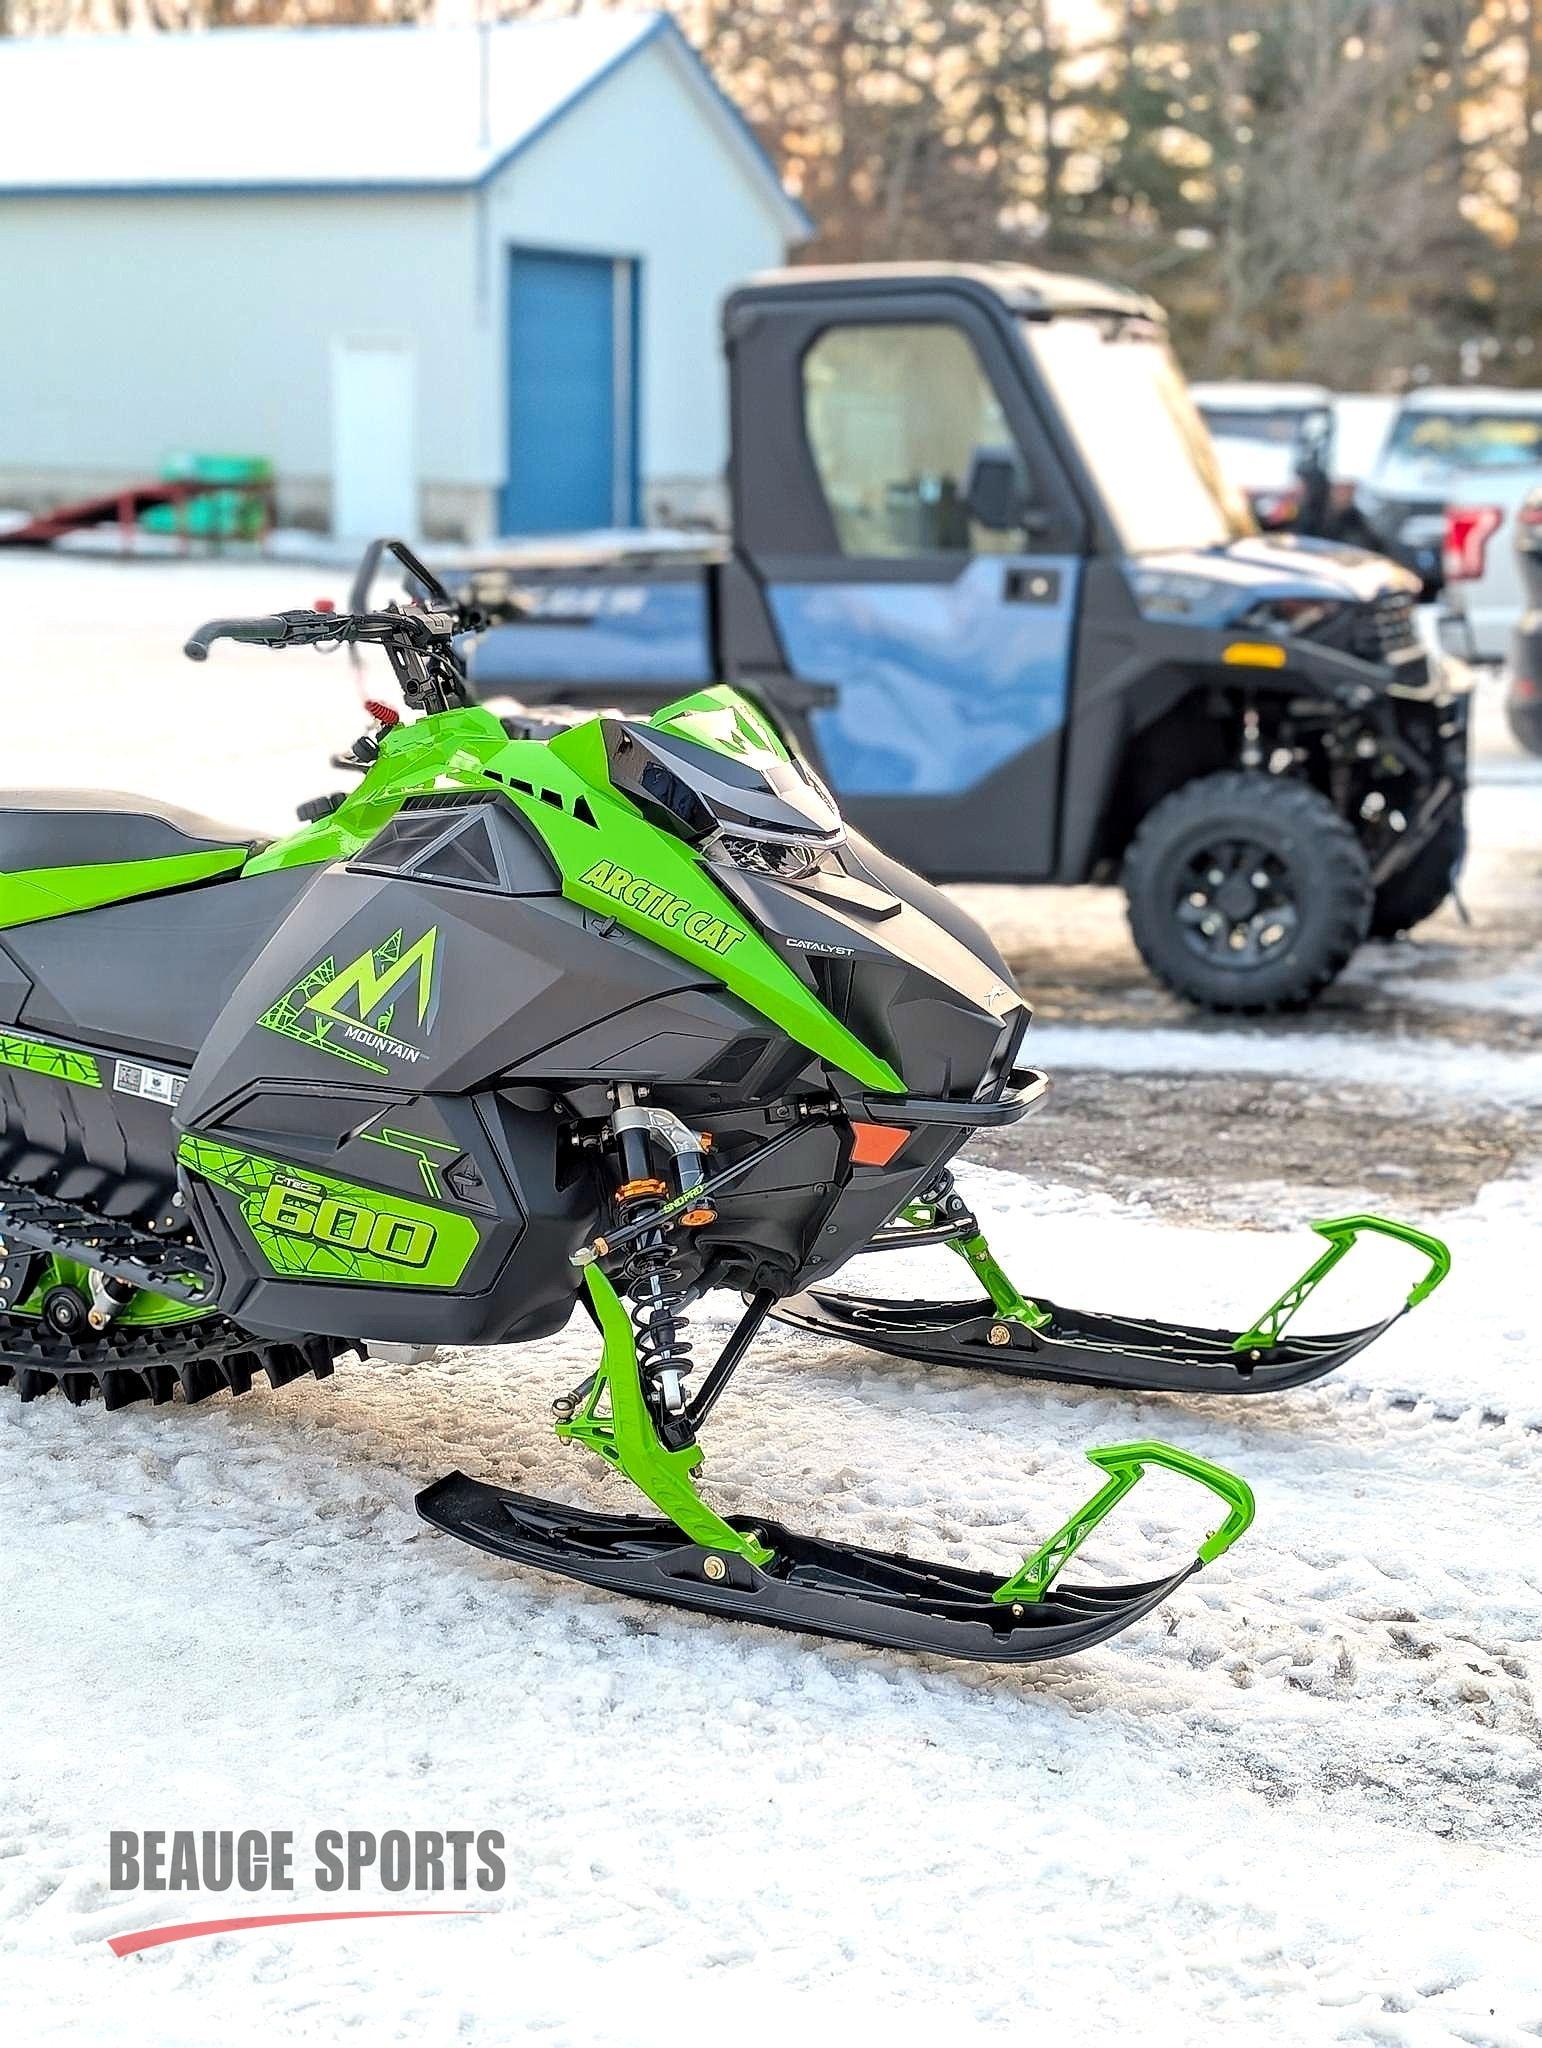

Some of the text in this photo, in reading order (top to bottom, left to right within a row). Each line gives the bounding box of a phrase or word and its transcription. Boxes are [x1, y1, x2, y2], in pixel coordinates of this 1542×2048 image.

[578, 859, 747, 955] ARCTIC CAT
[786, 938, 855, 956] CATALYST
[344, 1025, 421, 1063] MOUNTAIN
[260, 1184, 438, 1268] 600
